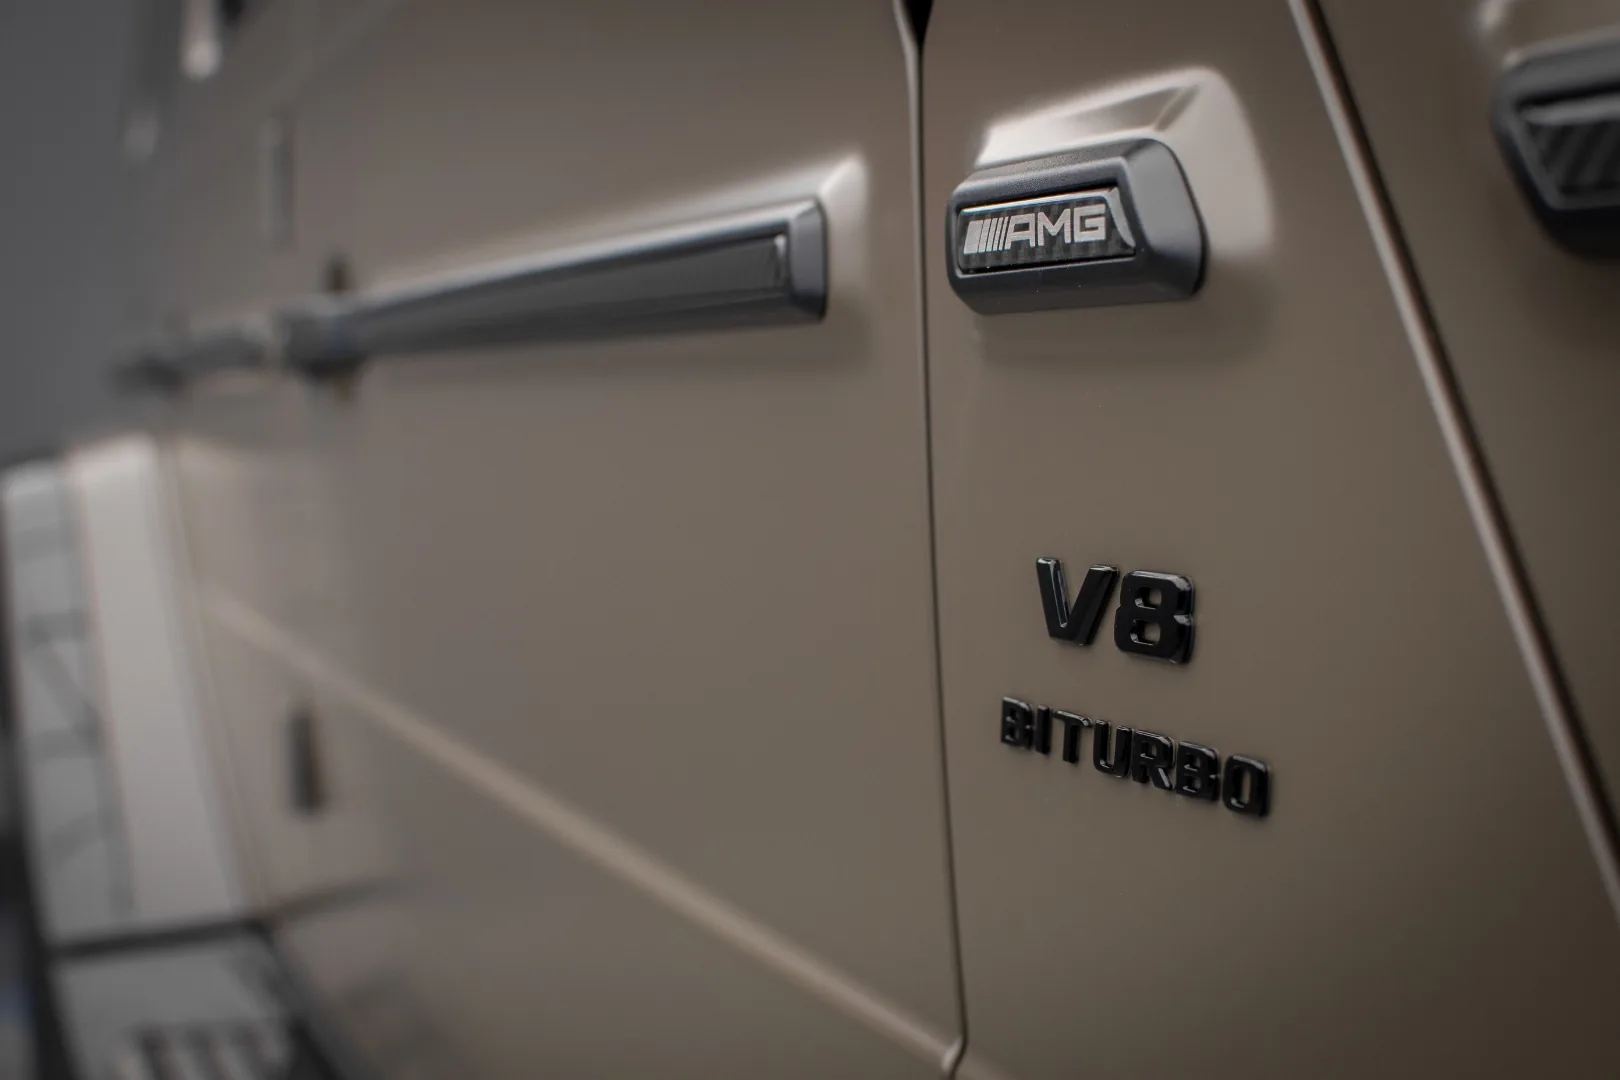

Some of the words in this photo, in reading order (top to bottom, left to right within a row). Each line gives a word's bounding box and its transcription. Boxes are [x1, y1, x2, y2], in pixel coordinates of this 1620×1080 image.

[1004, 203, 1106, 250] AMG
[1036, 556, 1196, 664] V8
[1000, 696, 1270, 817] BITURBO
